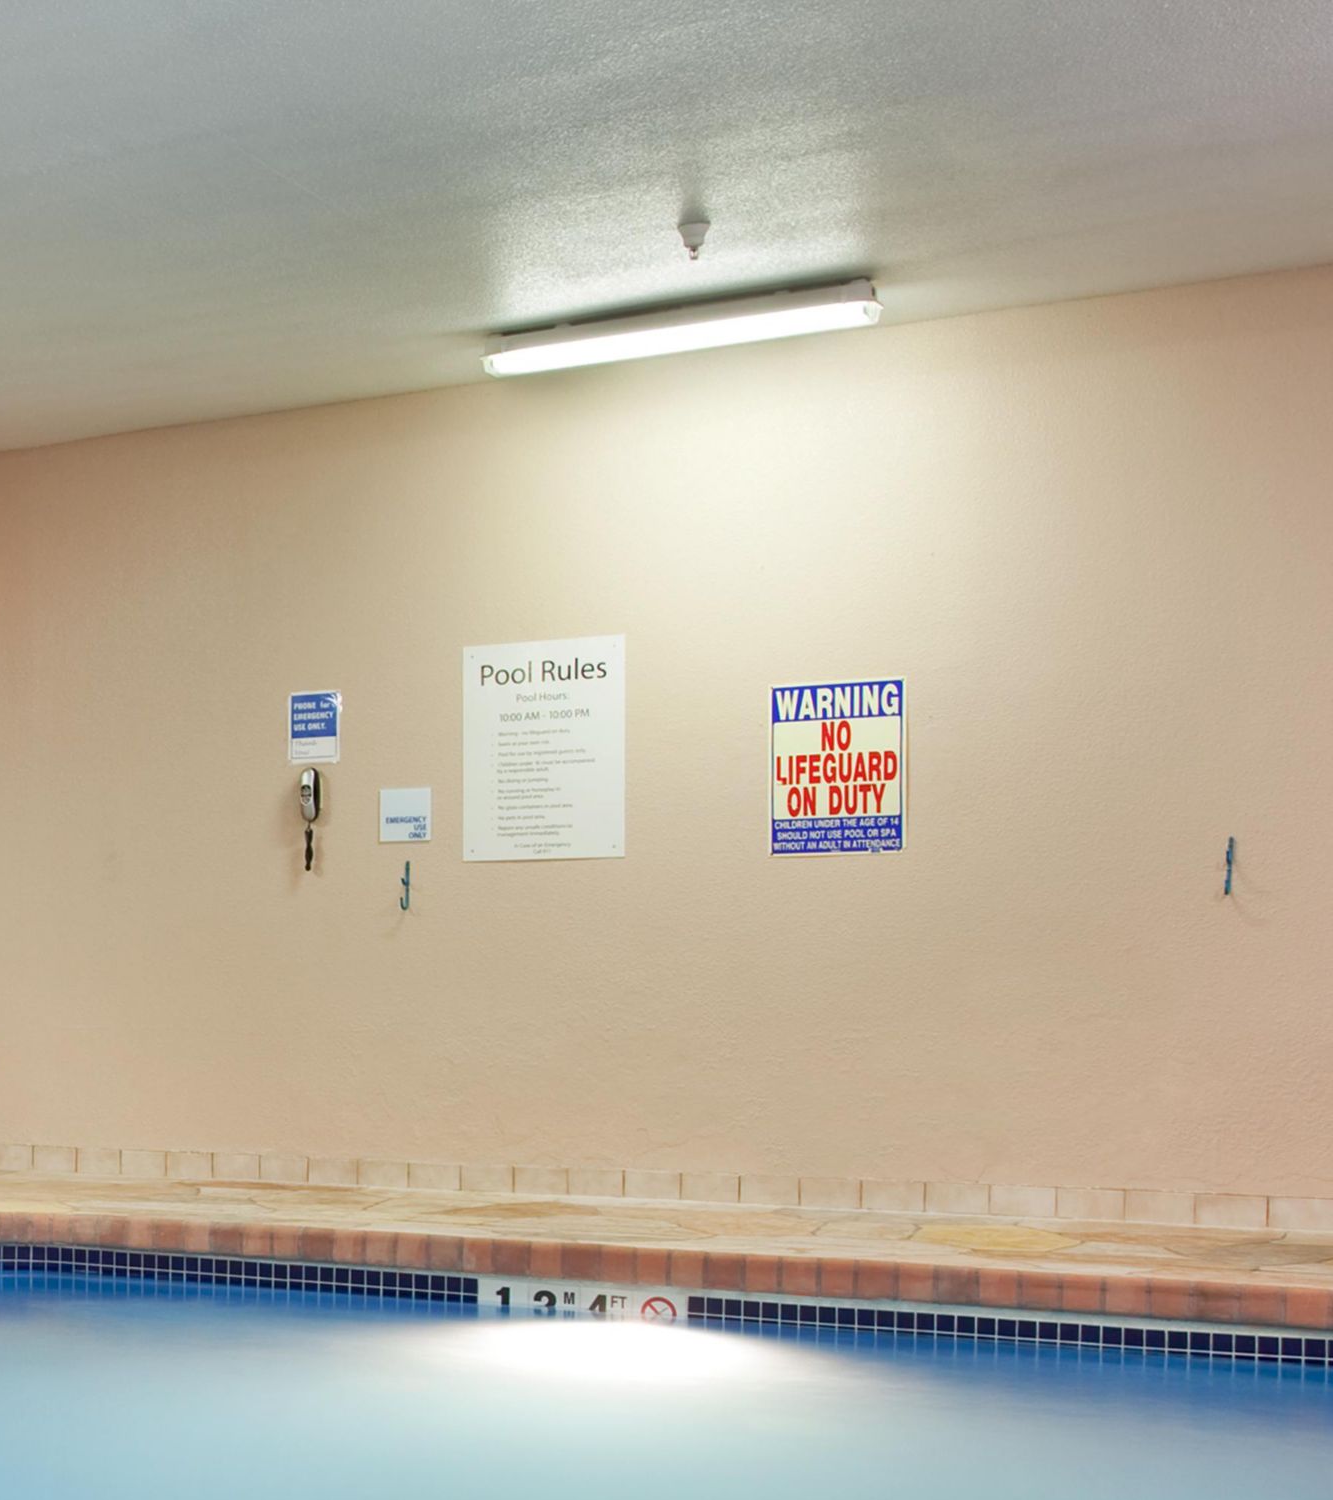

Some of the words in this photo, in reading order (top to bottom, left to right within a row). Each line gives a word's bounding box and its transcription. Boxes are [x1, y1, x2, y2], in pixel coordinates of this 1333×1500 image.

[481, 660, 532, 686] Pool
[541, 657, 607, 682] Rules
[516, 692, 537, 703] Pool
[775, 683, 900, 721] WARNING
[293, 702, 316, 710] PHONE
[293, 711, 333, 721] EMERGENCY
[499, 712, 523, 722] 10:00
[524, 711, 540, 720] AM
[549, 709, 573, 720] 10:00
[574, 708, 590, 718] PM
[293, 723, 306, 731] USE
[821, 720, 852, 752] NO
[776, 750, 898, 785] LIFEGUARD
[787, 786, 817, 818] ON
[829, 783, 886, 816] DUTY
[386, 816, 426, 824] EMERGENCY
[774, 820, 813, 830] CHILDREN
[814, 818, 840, 829] UNDER
[843, 818, 857, 828] THE
[859, 817, 875, 827] AGE
[877, 816, 888, 827] OF
[891, 816, 900, 826] 14
[777, 830, 808, 841] SHOULD
[809, 830, 826, 840] NOT
[827, 829, 842, 840] USE
[844, 829, 866, 839] POOL
[867, 828, 879, 838] OR
[880, 827, 896, 838] SPA
[773, 841, 805, 851] WITHOUT
[807, 841, 818, 850] AN
[819, 840, 841, 850] ADULT
[843, 840, 852, 850] IN
[852, 838, 900, 849] ATTENDANCE
